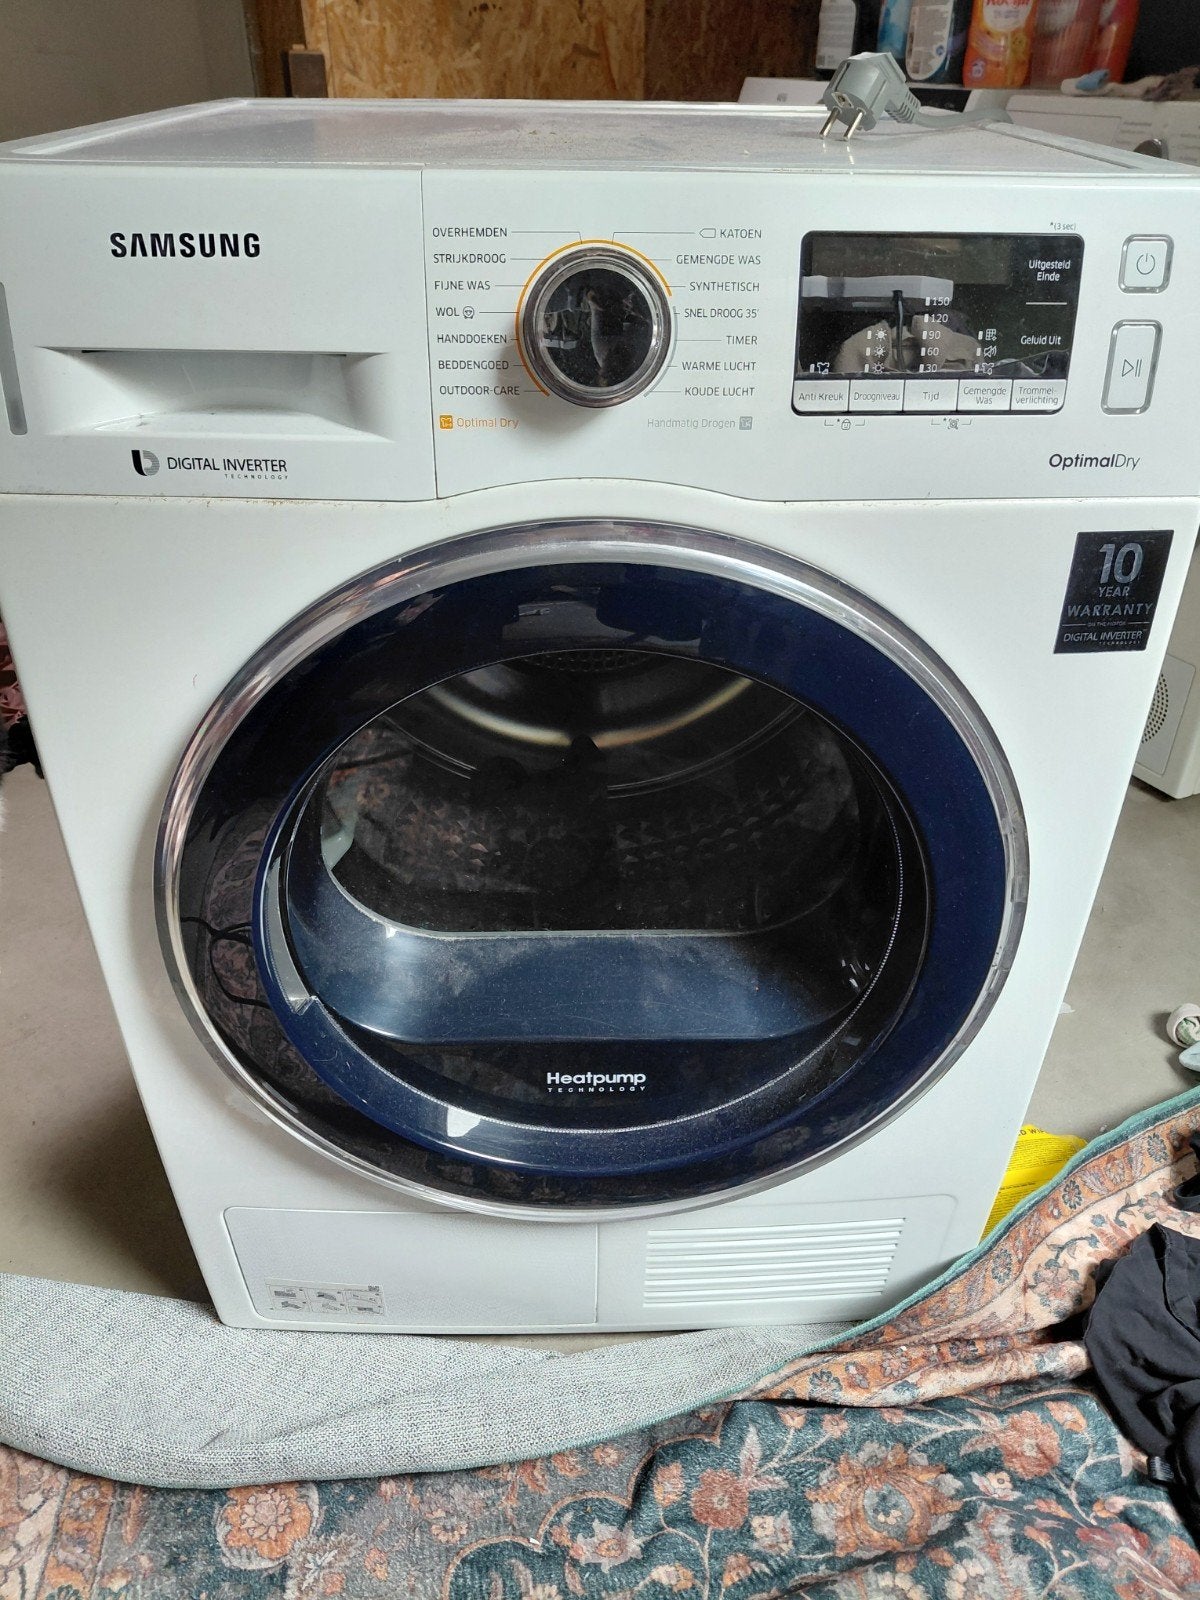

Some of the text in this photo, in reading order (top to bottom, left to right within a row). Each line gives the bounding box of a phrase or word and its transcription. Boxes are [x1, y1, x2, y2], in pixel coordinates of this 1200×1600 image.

[432, 227, 508, 238] OVERHEMDEN
[720, 228, 762, 239] KATOEN
[109, 232, 261, 258] SAMSUNG
[433, 253, 507, 264] STRIJKDROOG
[676, 254, 761, 265] GEMENGDE WAS
[1028, 259, 1071, 271] Uitgesteld
[1036, 271, 1061, 281] Einde
[434, 280, 491, 291] FIJNE WAS
[689, 281, 760, 292] SYNTHETISCH
[932, 296, 950, 306] 150
[435, 306, 460, 317] WOL
[684, 308, 707, 318] SNEL
[710, 308, 743, 318] DROOG
[930, 313, 949, 323] 120
[437, 333, 507, 344] HANDDOEKEN
[726, 335, 758, 345] TIMER
[928, 330, 941, 340] 90
[1020, 335, 1062, 345] Geluid Uit
[926, 347, 940, 356] 60
[438, 360, 509, 370] BEDDENGOED
[682, 361, 757, 371] WARME LUCHT
[925, 363, 938, 373] 30
[439, 385, 521, 396] OUTDOOR-CARE
[684, 387, 755, 396] KOUDE LUCHT
[963, 386, 1007, 398] Gemengde
[798, 392, 844, 401] Anti Kreuk
[853, 391, 901, 403] Droogniveau
[922, 391, 940, 402] Tijd
[975, 396, 993, 405] Was
[1015, 396, 1059, 406] verlichting
[456, 417, 519, 429] Optimal Dry
[647, 418, 736, 429] Handmatig Drogen
[166, 457, 288, 472] DIGITAL INVERTER
[1099, 542, 1145, 584] 10
[1098, 586, 1130, 598] YEAR
[1067, 603, 1154, 618] WARRANTY
[1063, 630, 1143, 642] DIGITAL INVERTER
[546, 1071, 647, 1087] Heatpump
